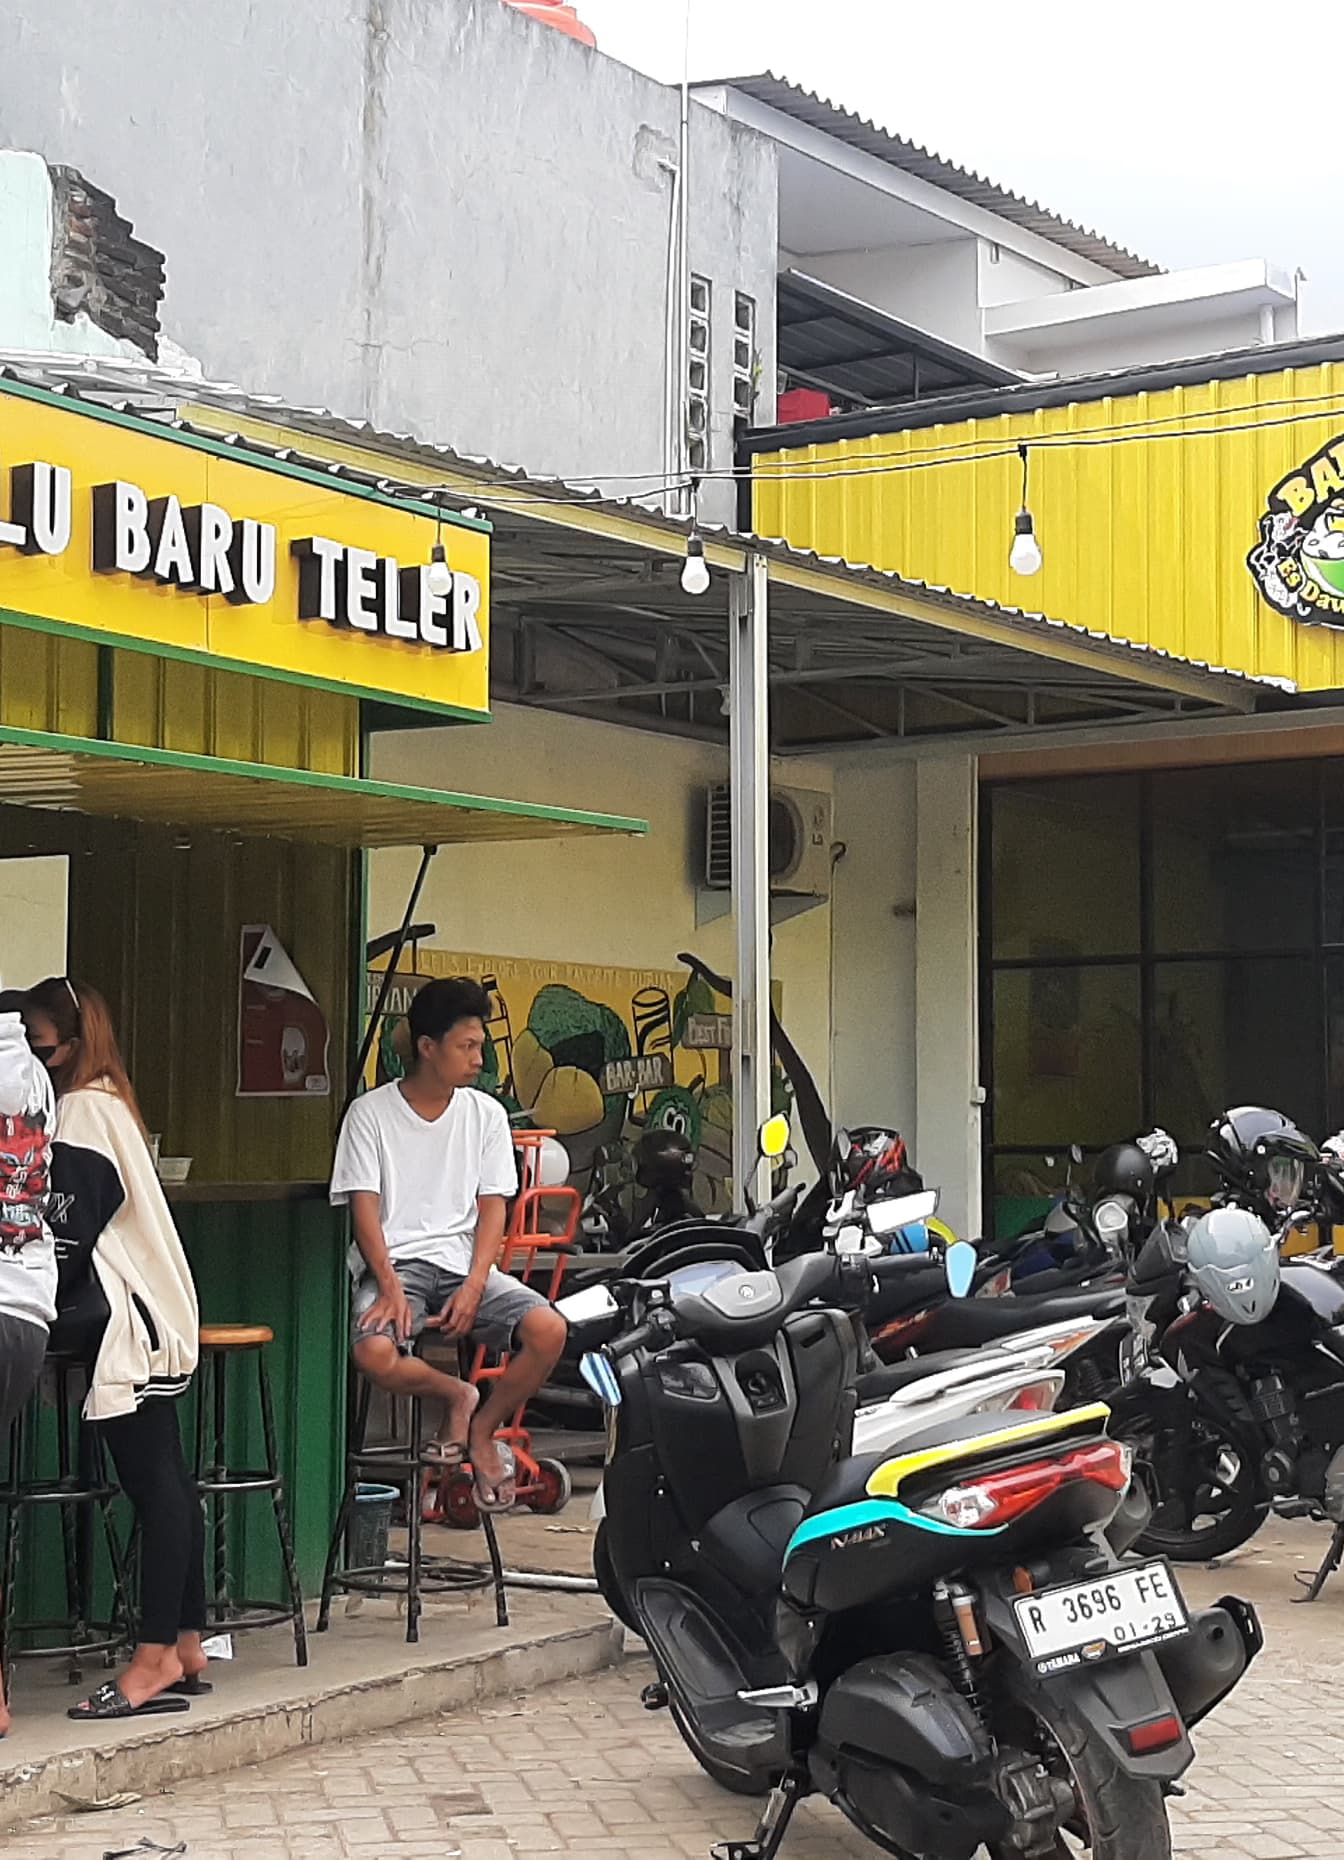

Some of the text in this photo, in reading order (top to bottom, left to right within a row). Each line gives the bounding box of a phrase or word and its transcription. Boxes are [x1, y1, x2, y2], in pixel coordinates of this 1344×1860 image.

[112, 480, 277, 604] BARU
[306, 536, 484, 652] TELER
[1278, 557, 1303, 587] Es
[1027, 1571, 1168, 1635] R 3696 FE
